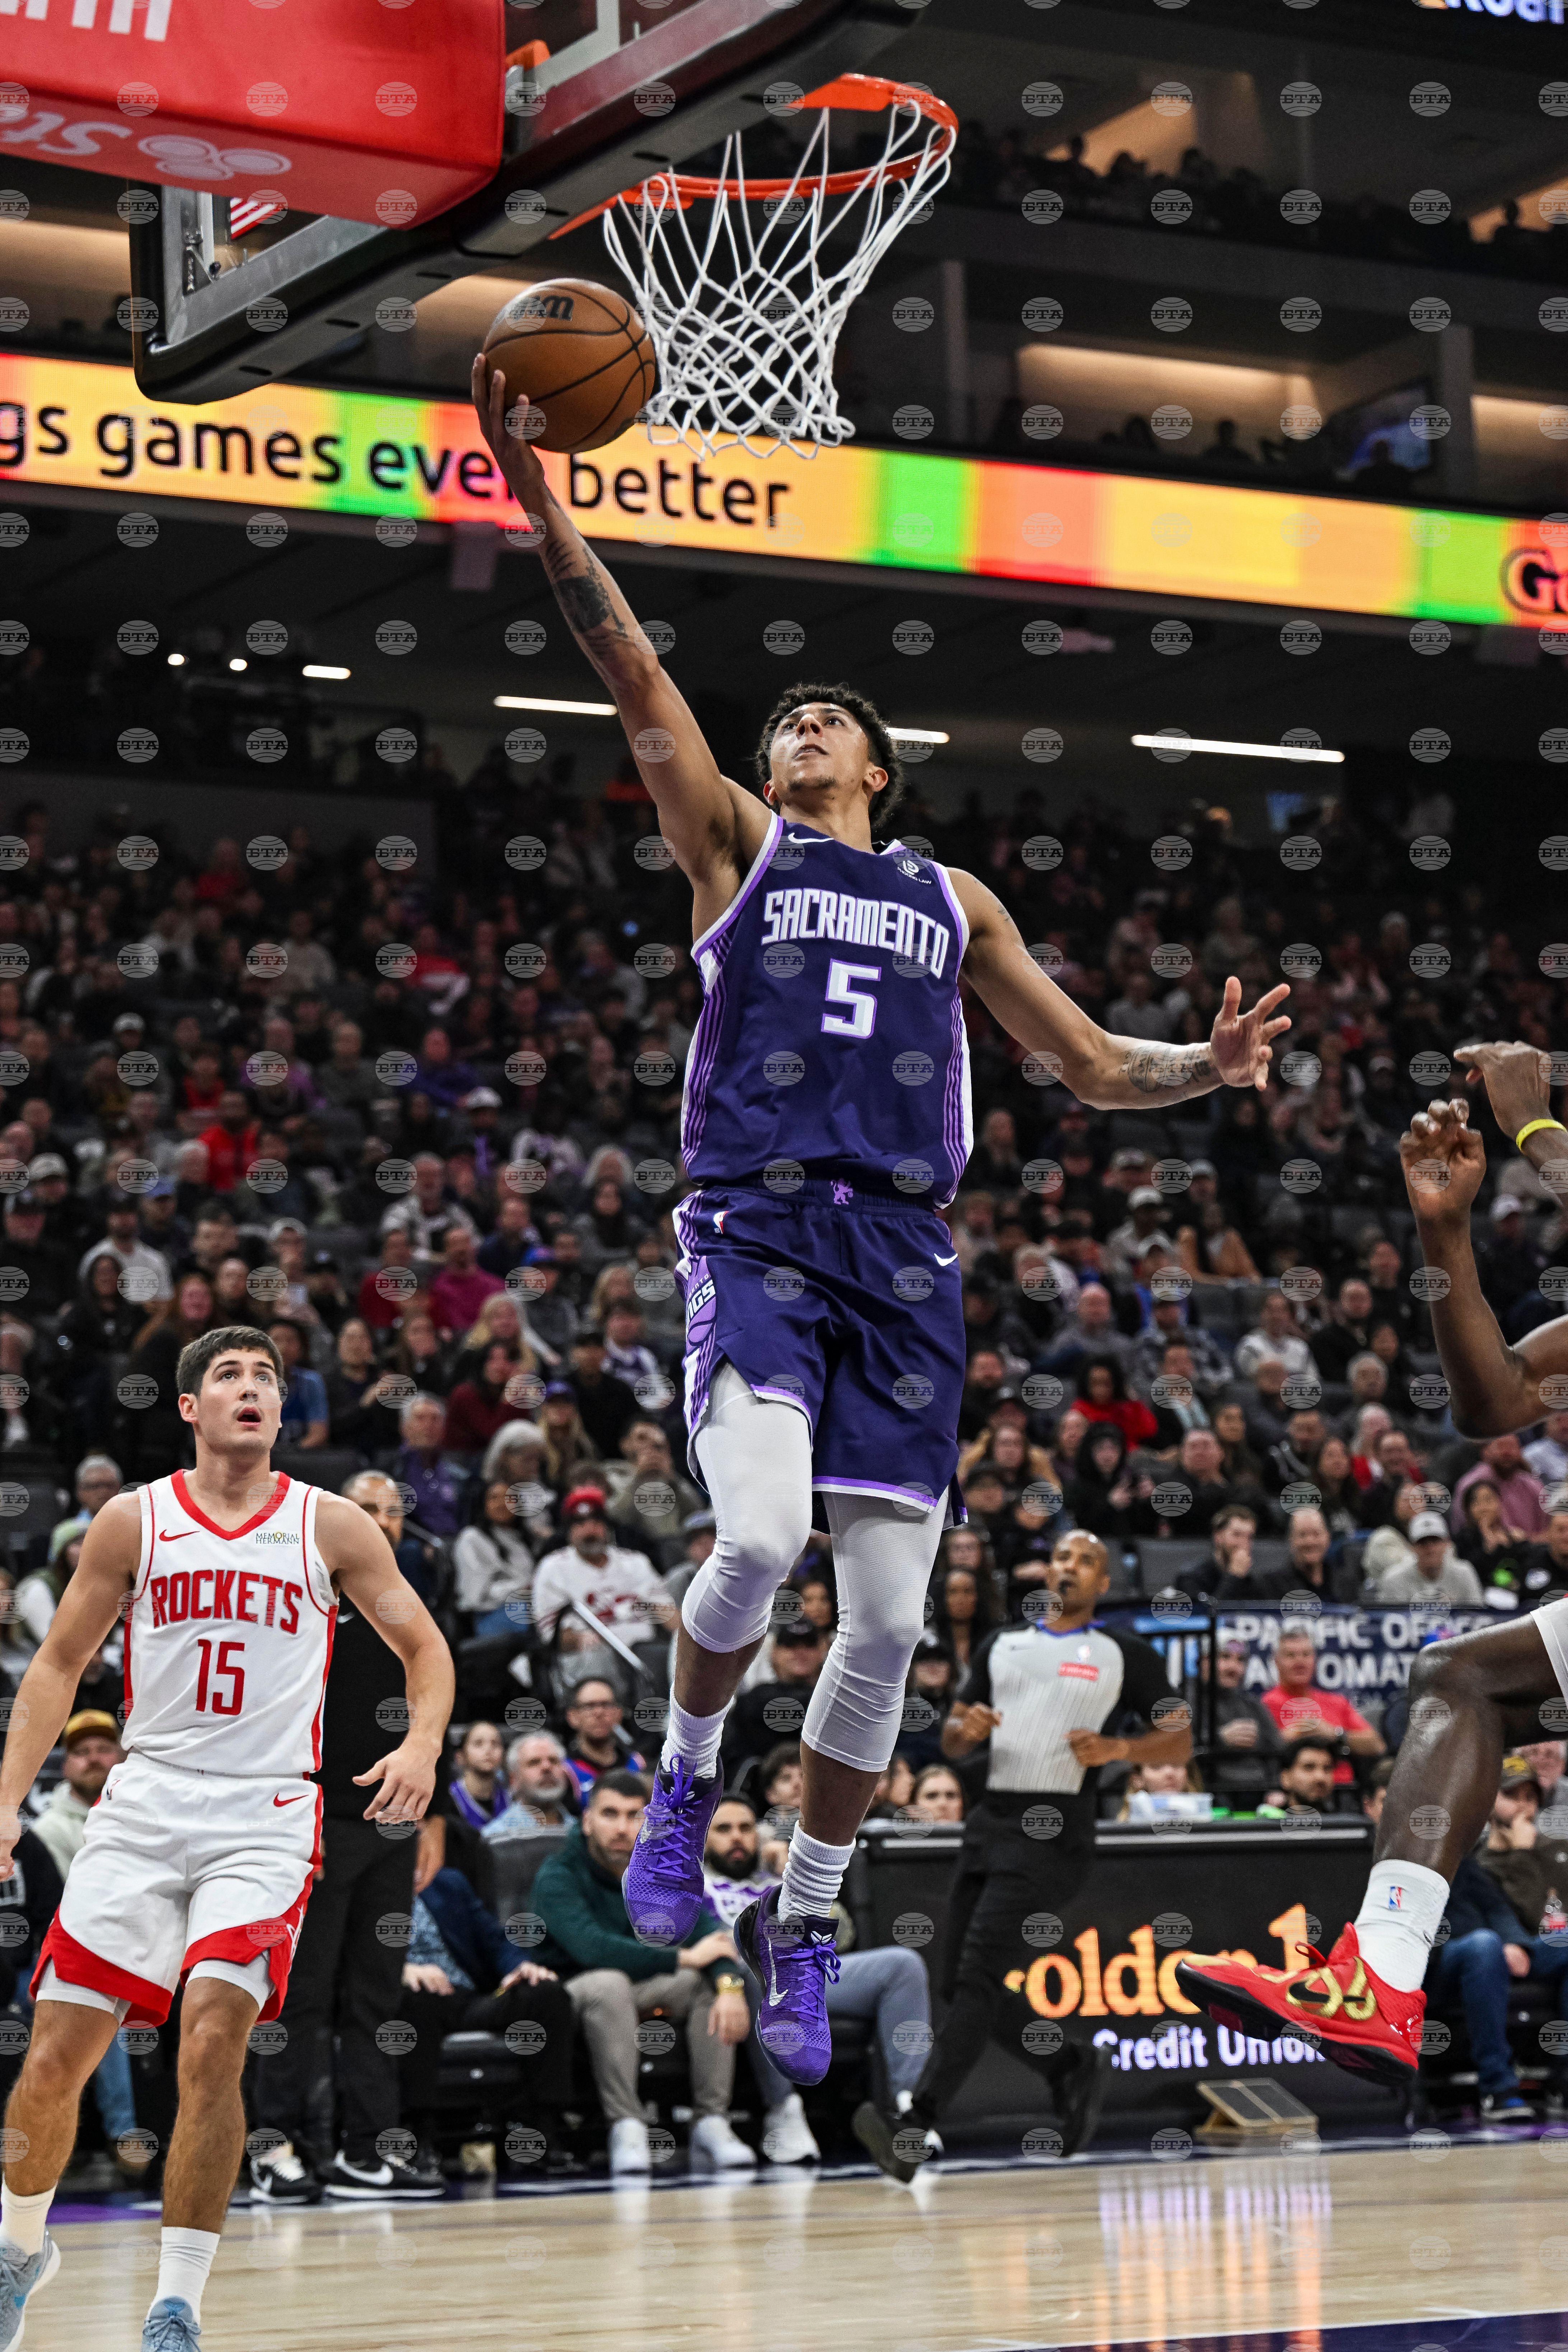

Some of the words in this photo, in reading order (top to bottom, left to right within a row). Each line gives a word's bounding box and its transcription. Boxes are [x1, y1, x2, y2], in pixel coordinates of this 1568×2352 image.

[96, 411, 342, 483] games
[368, 439, 513, 501] eve
[569, 453, 789, 526] better
[761, 887, 950, 980] SACRAMENTO
[821, 958, 882, 1039] 5
[150, 1569, 304, 1635] ROCKETS
[195, 1639, 245, 1716] 15
